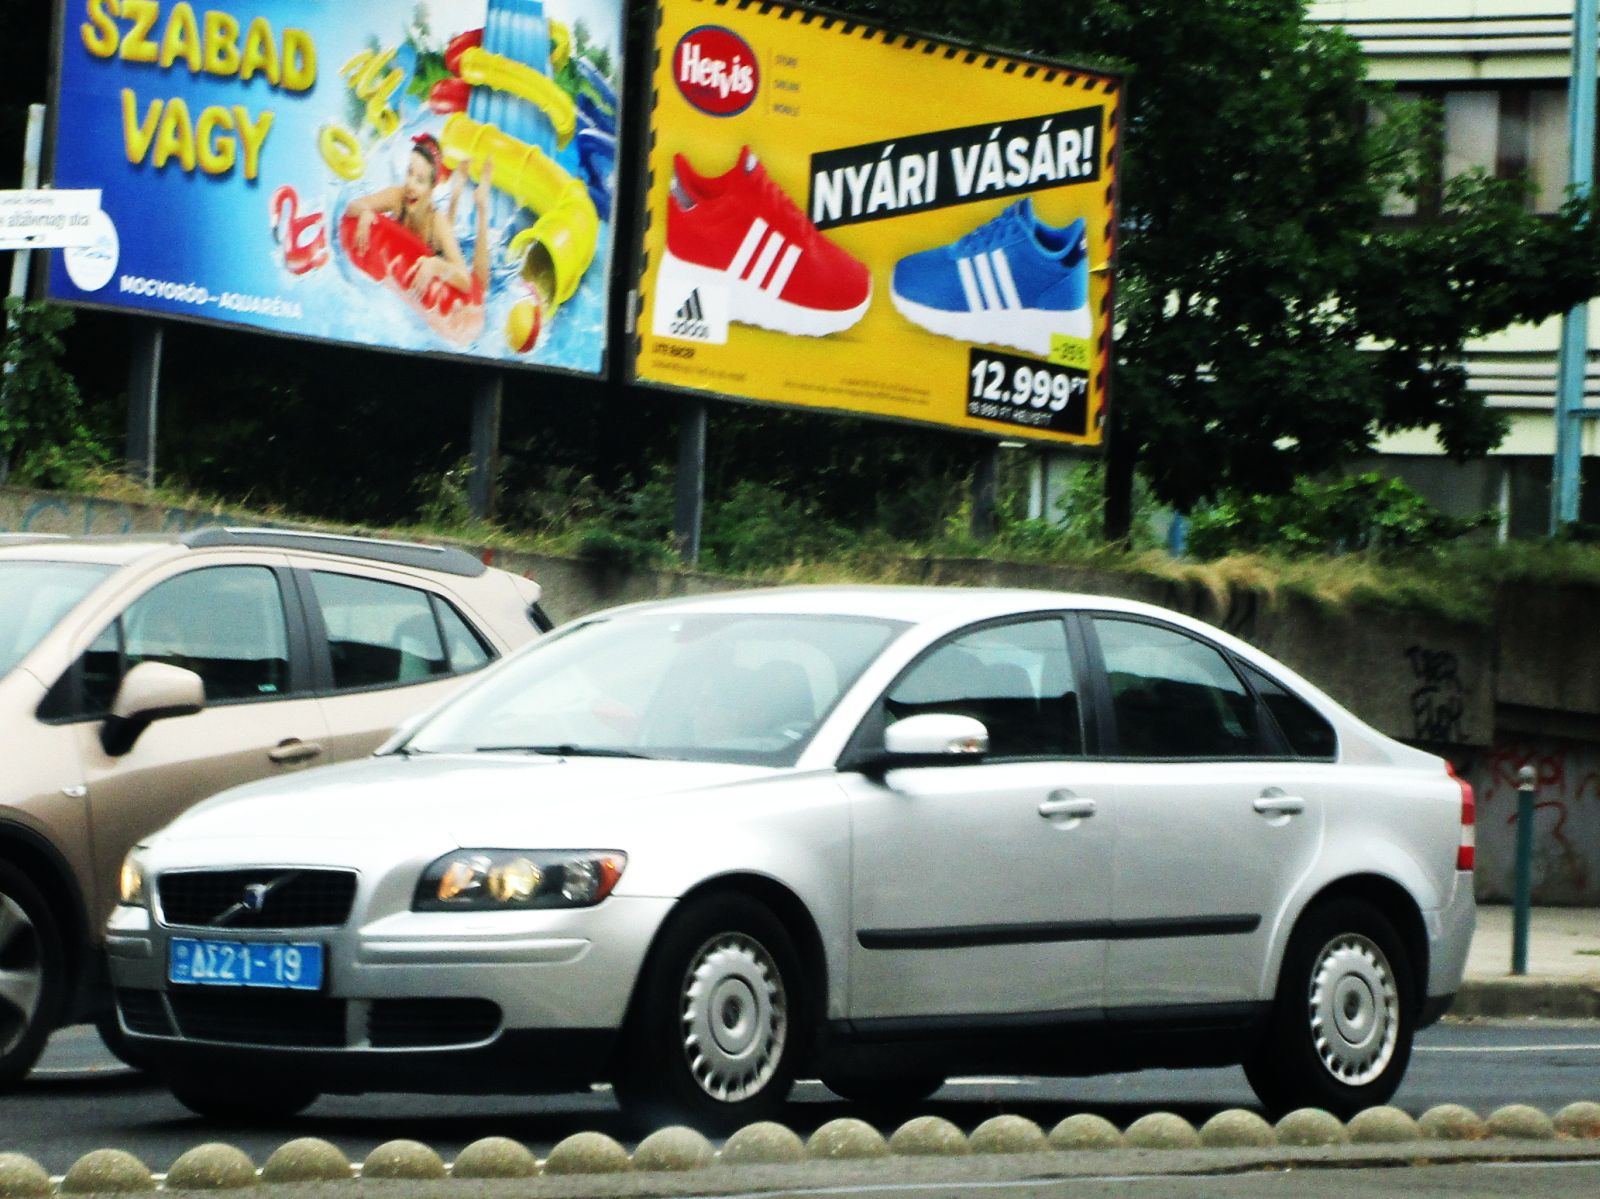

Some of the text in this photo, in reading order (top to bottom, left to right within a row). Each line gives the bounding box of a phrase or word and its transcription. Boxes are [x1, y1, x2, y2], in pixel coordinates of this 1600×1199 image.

[81, 0, 316, 90] SZABAD
[680, 42, 753, 98] Hervis
[121, 88, 275, 180] VAGY
[813, 119, 1095, 223] NYÁRI VÁSÁR!
[971, 359, 1070, 412] 12.999
